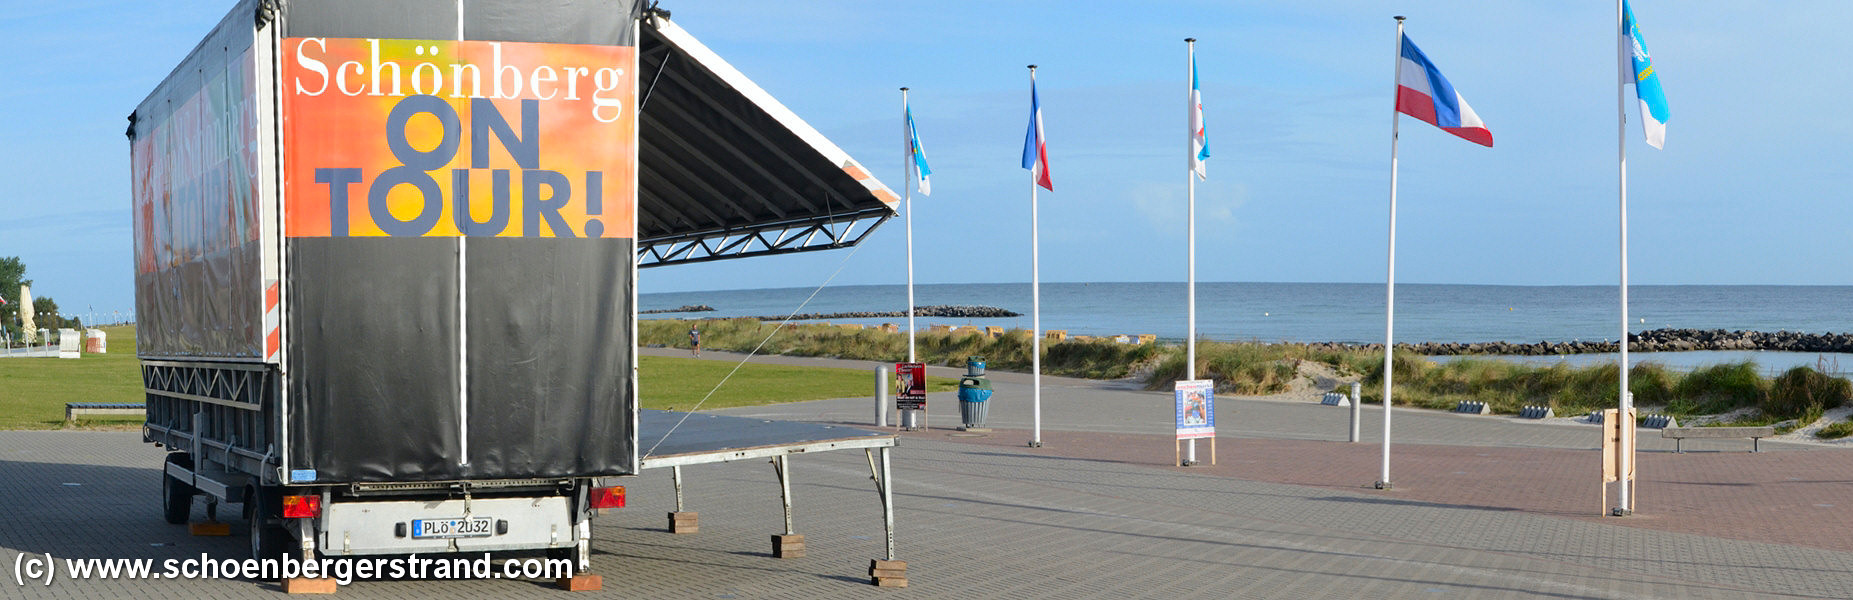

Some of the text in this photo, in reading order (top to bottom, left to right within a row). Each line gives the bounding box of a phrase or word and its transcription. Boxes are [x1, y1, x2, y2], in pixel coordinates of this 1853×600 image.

[295, 37, 624, 123] Schönberg
[386, 94, 540, 172] ON
[314, 165, 605, 238] TOUR!
[424, 520, 489, 534] PLÖ 2032
